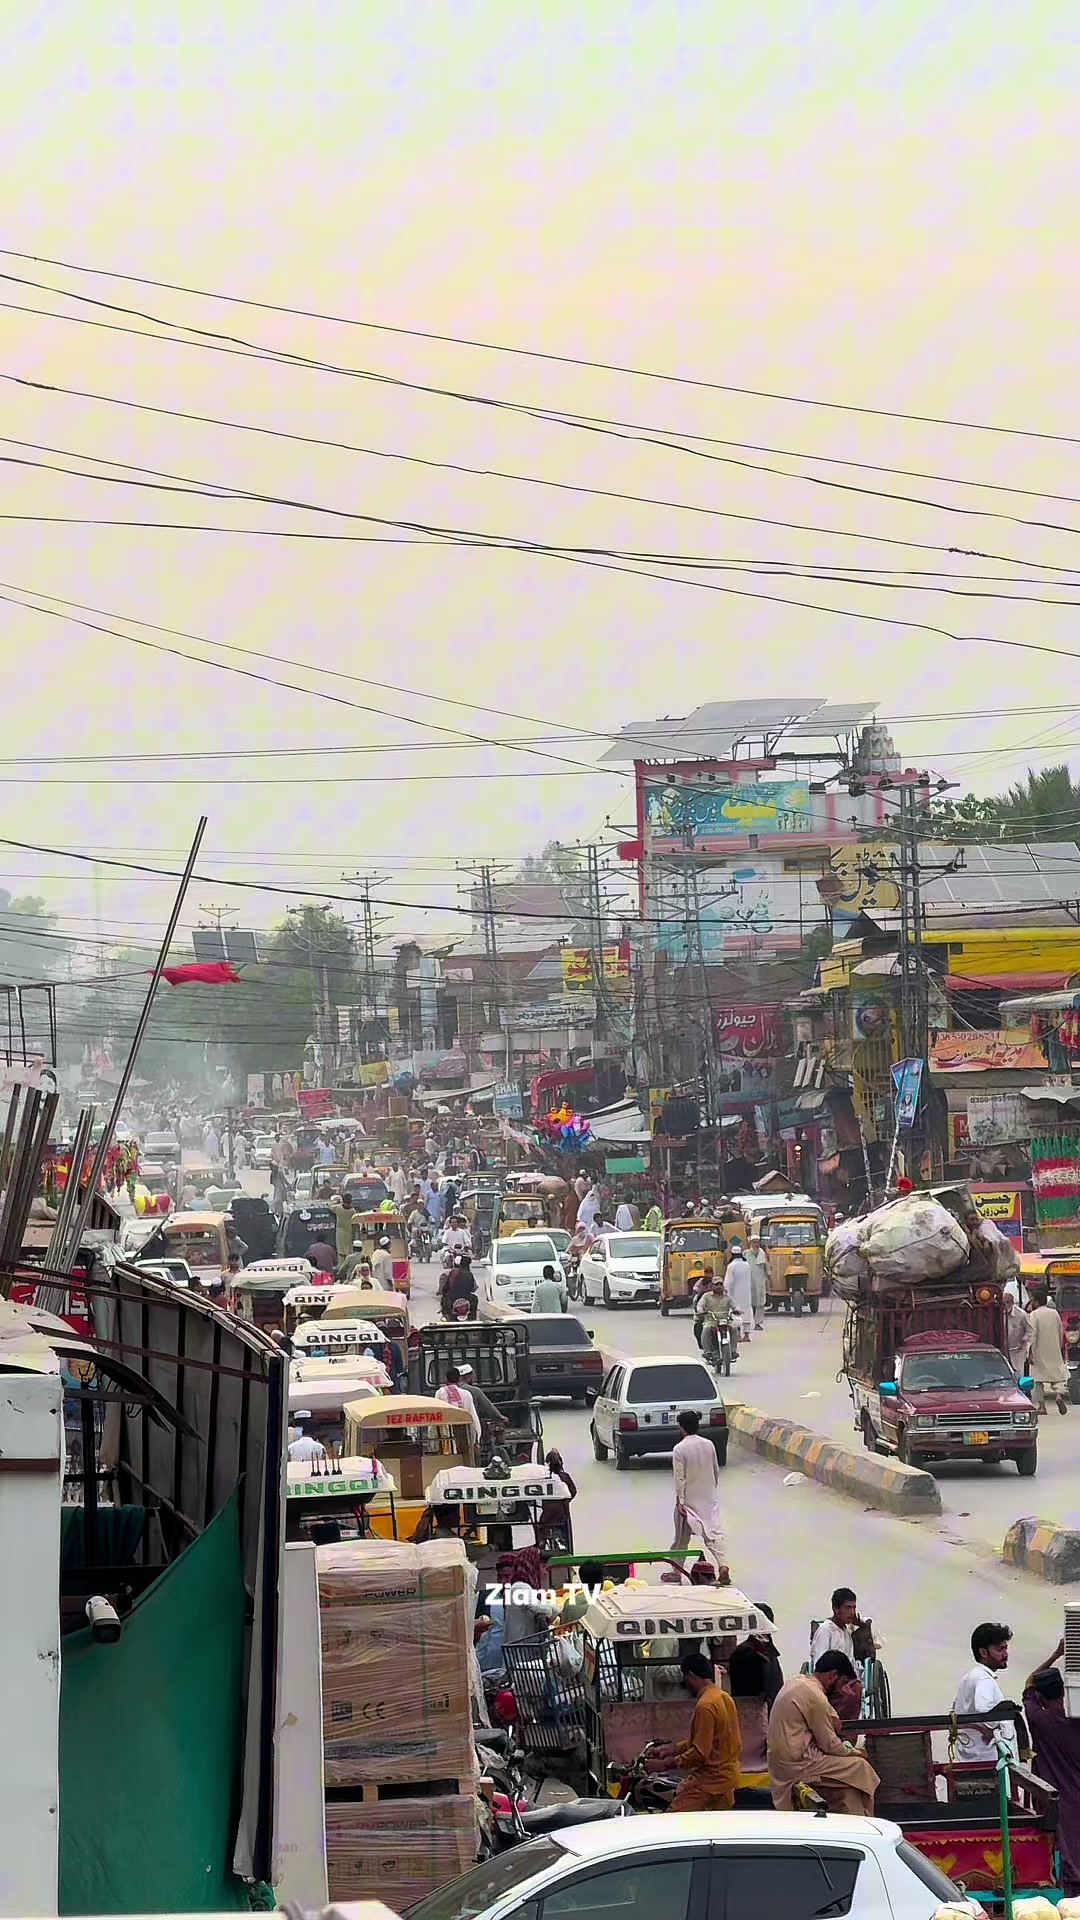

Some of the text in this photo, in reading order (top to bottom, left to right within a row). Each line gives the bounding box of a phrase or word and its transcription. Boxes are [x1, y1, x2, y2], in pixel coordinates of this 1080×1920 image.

[495, 1082, 518, 1095] SHAH
[975, 1194, 1012, 1207] حسن
[306, 1332, 379, 1343] QINGQI
[386, 1412, 443, 1424] TEZ RAFTAR
[444, 1483, 553, 1500] QINGQI
[616, 1614, 758, 1635] QINGQI
